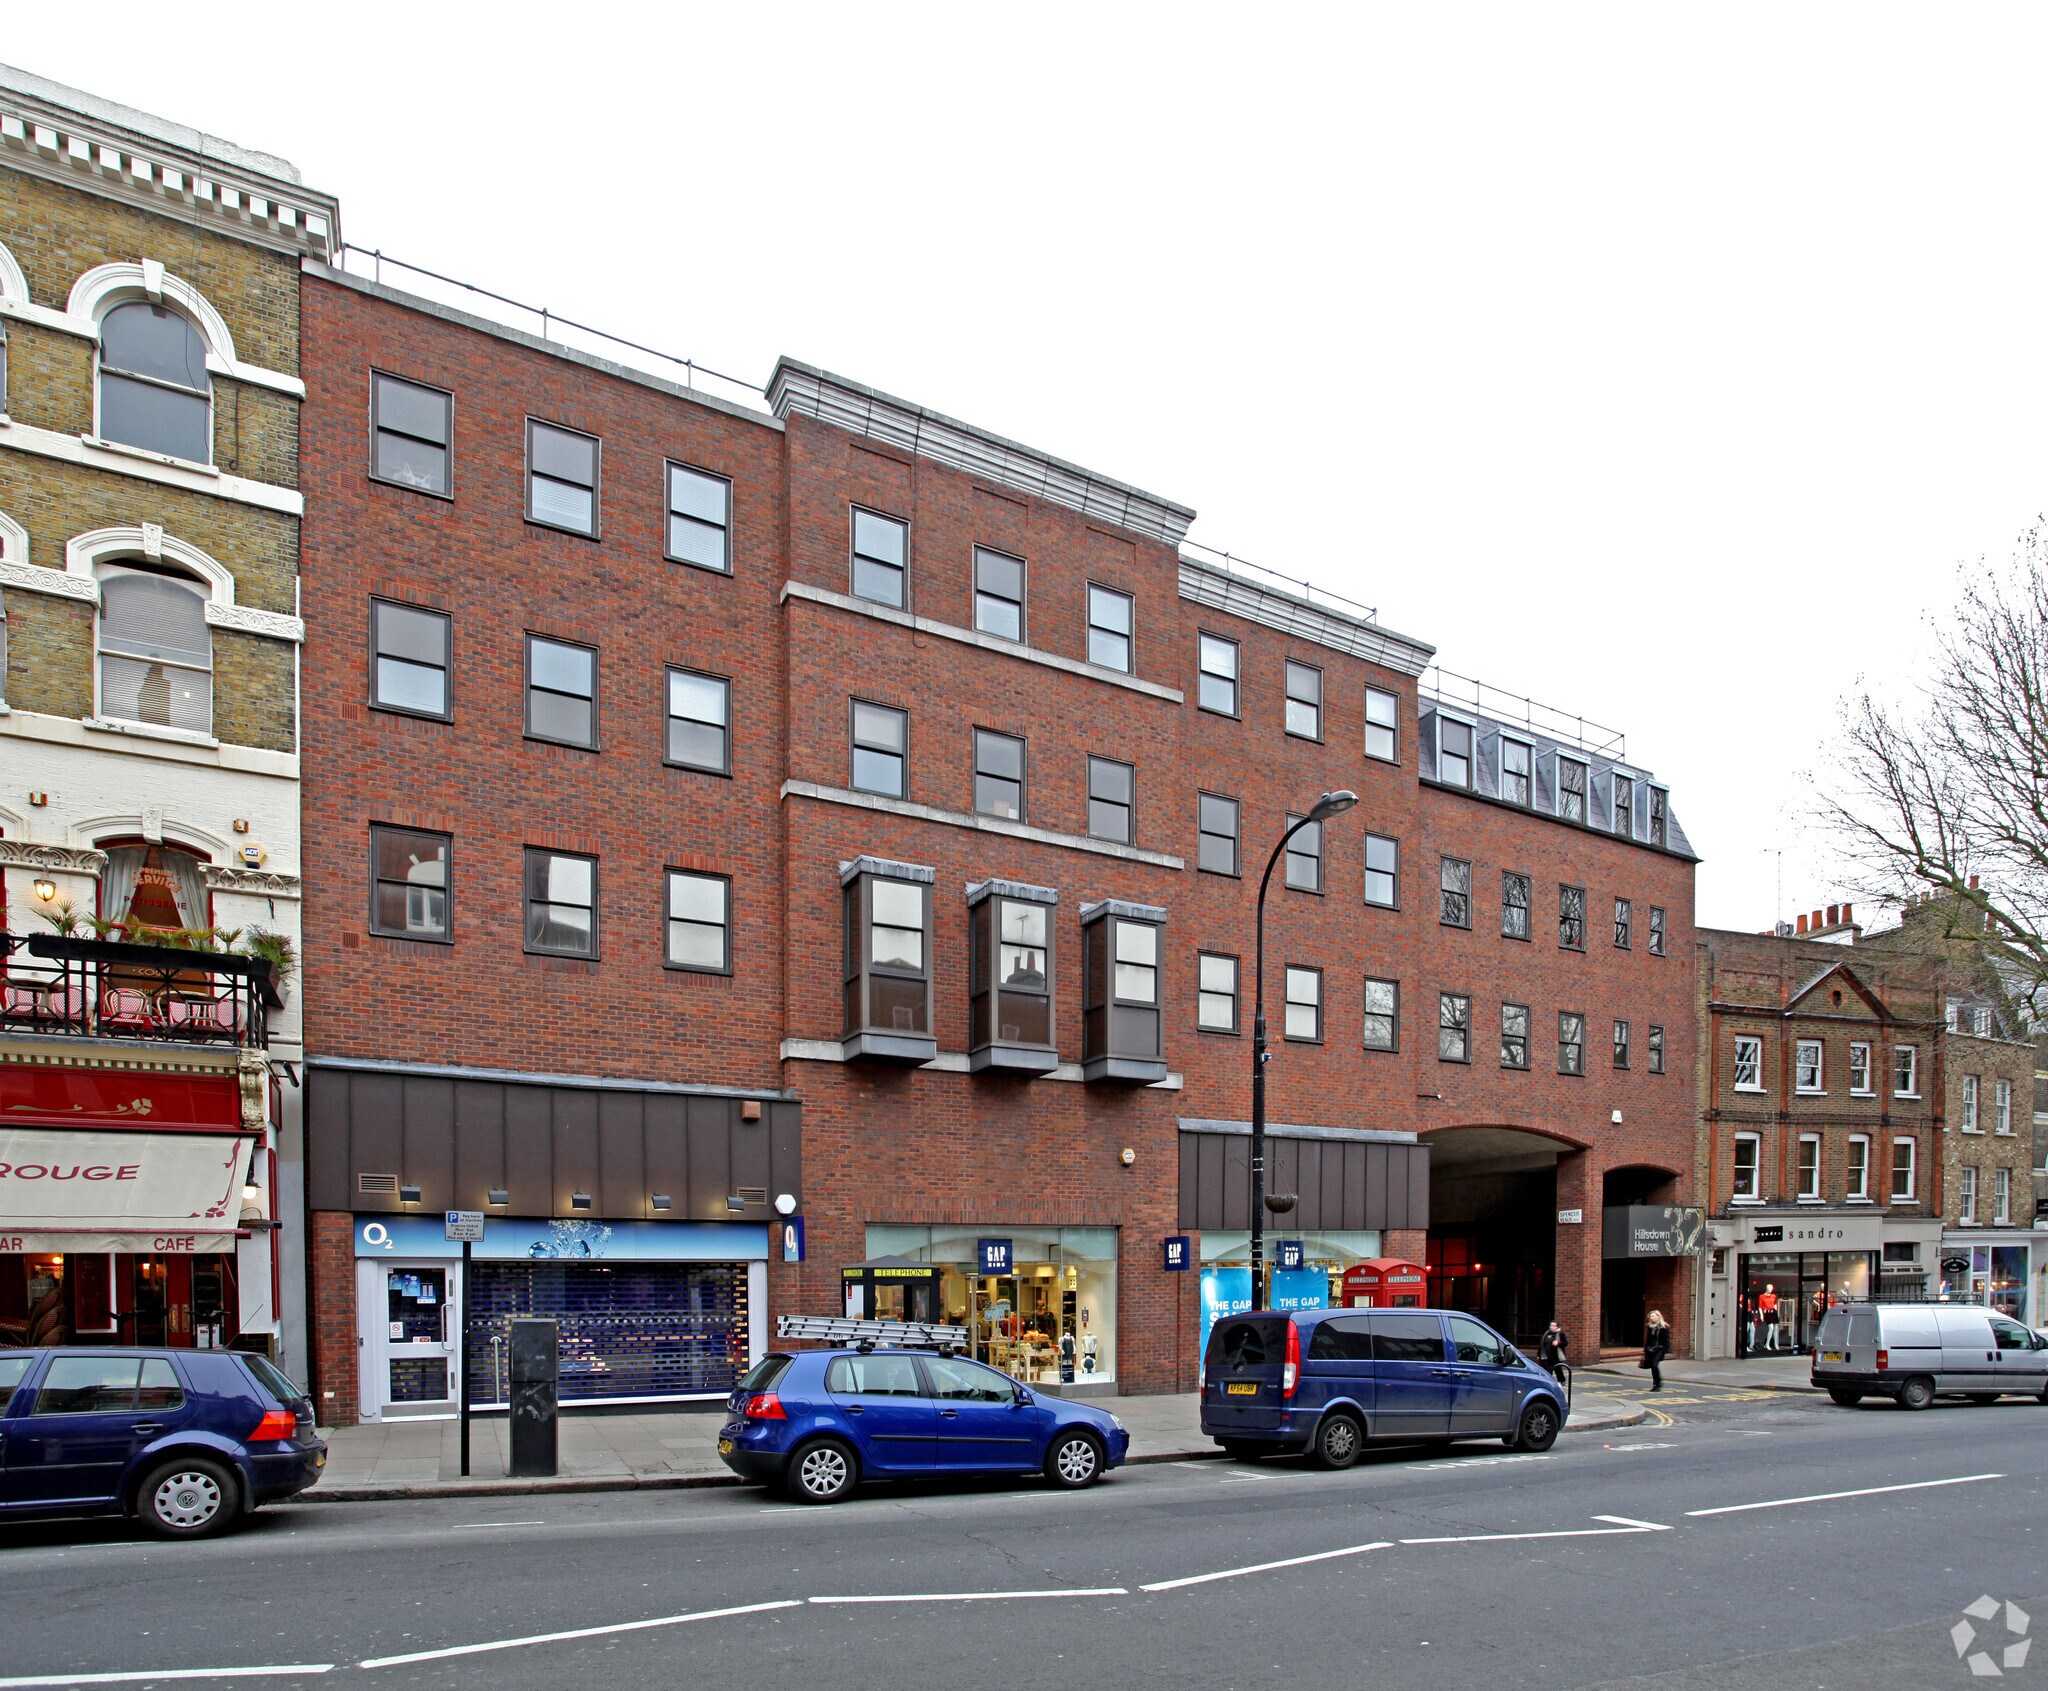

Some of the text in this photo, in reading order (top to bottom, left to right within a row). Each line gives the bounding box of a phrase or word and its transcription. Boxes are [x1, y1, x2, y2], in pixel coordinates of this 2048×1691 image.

[245, 848, 258, 857] ADT
[138, 866, 174, 878] PREMIER
[131, 874, 182, 893] SERVICE
[124, 895, 188, 911] PATISSERIE
[449, 1213, 457, 1222] P
[363, 1222, 394, 1250] O2
[1634, 1229, 1670, 1240] Hillsdown
[1664, 1207, 1705, 1256] 32
[1789, 1227, 1843, 1239] sandro
[154, 1236, 195, 1251] CAFÉ
[1634, 1241, 1659, 1252] House
[987, 1246, 1006, 1262] GAP
[1168, 1243, 1182, 1259] GAP
[1284, 1252, 1299, 1265] GAP
[881, 1269, 926, 1277] TELEPHONE
[1389, 1275, 1420, 1283] TELEPHONE
[1209, 1300, 1252, 1311] THE GAP
[1280, 1297, 1320, 1307] THE GAP
